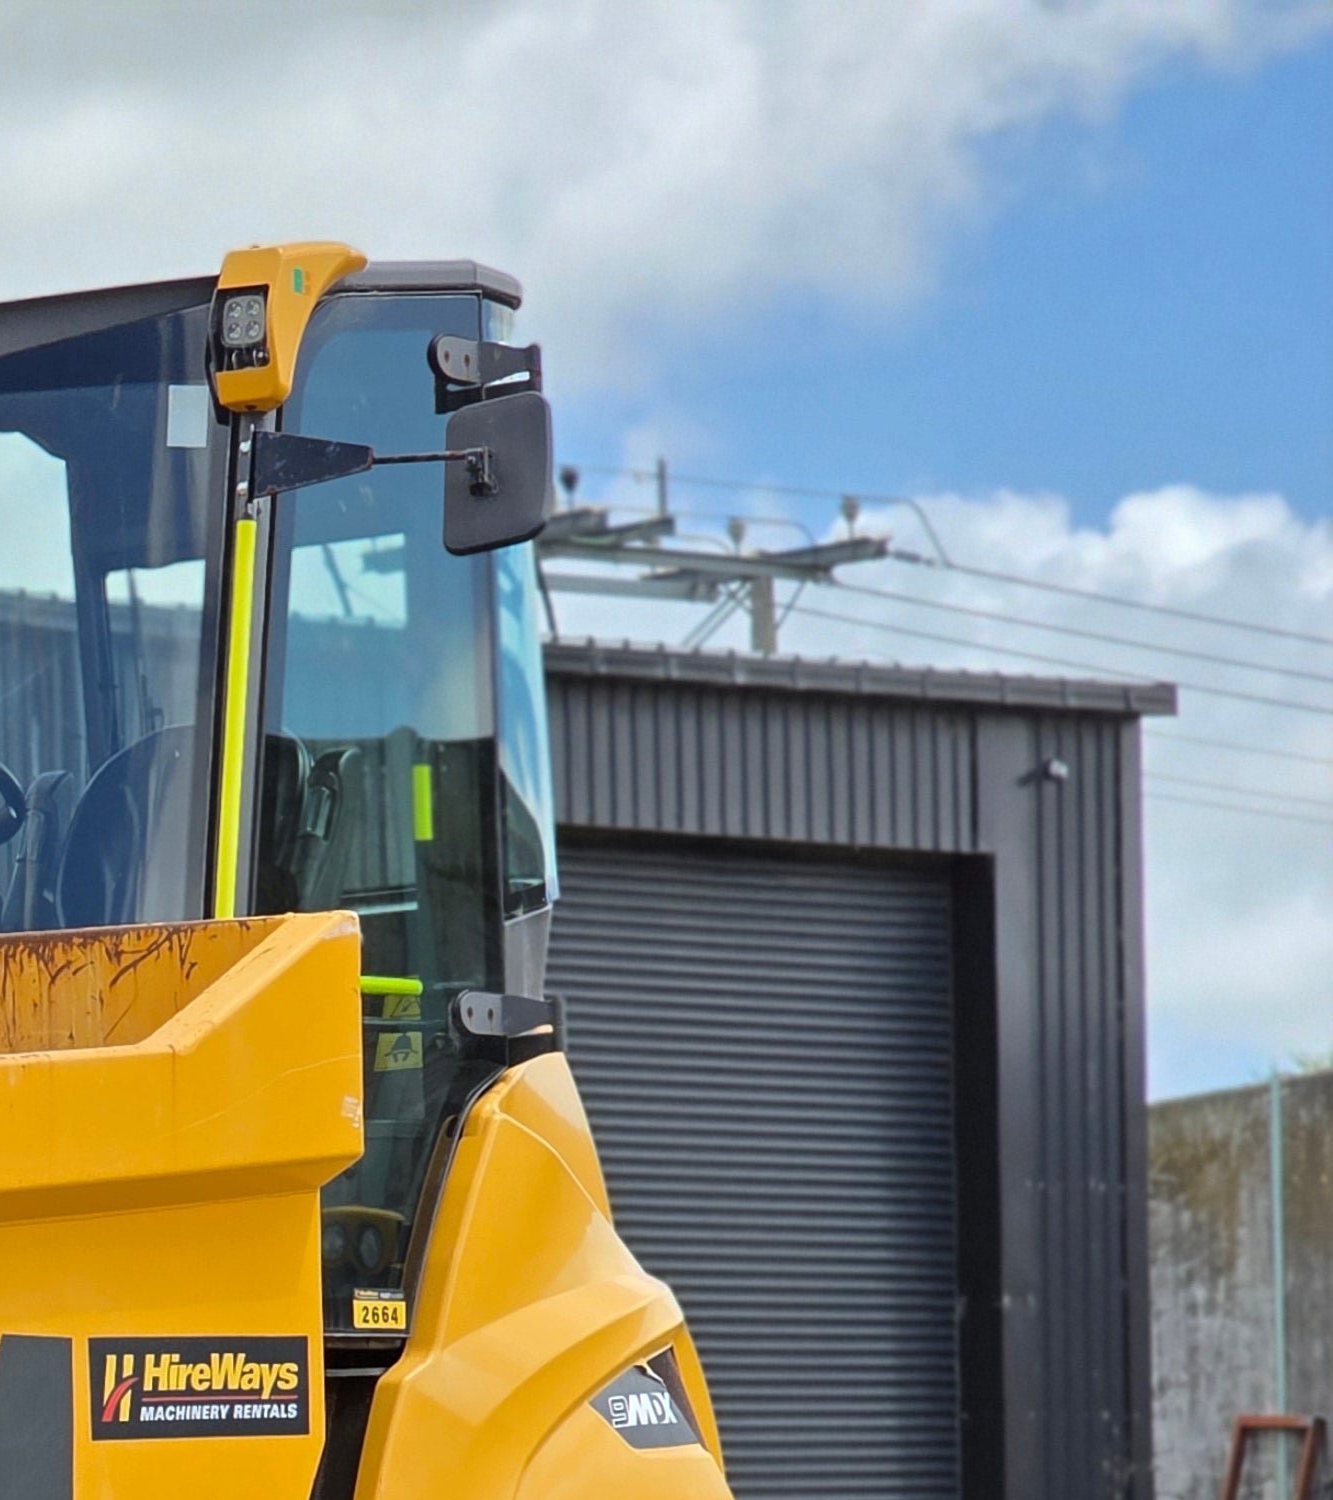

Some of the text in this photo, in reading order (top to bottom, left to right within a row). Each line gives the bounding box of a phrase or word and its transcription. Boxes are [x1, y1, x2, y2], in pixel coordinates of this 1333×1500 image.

[361, 1305, 399, 1325] 2664
[143, 1353, 299, 1400] HireWays
[140, 1403, 298, 1422] MACHINERY RENTALS
[608, 1391, 678, 1429] 9MDX
